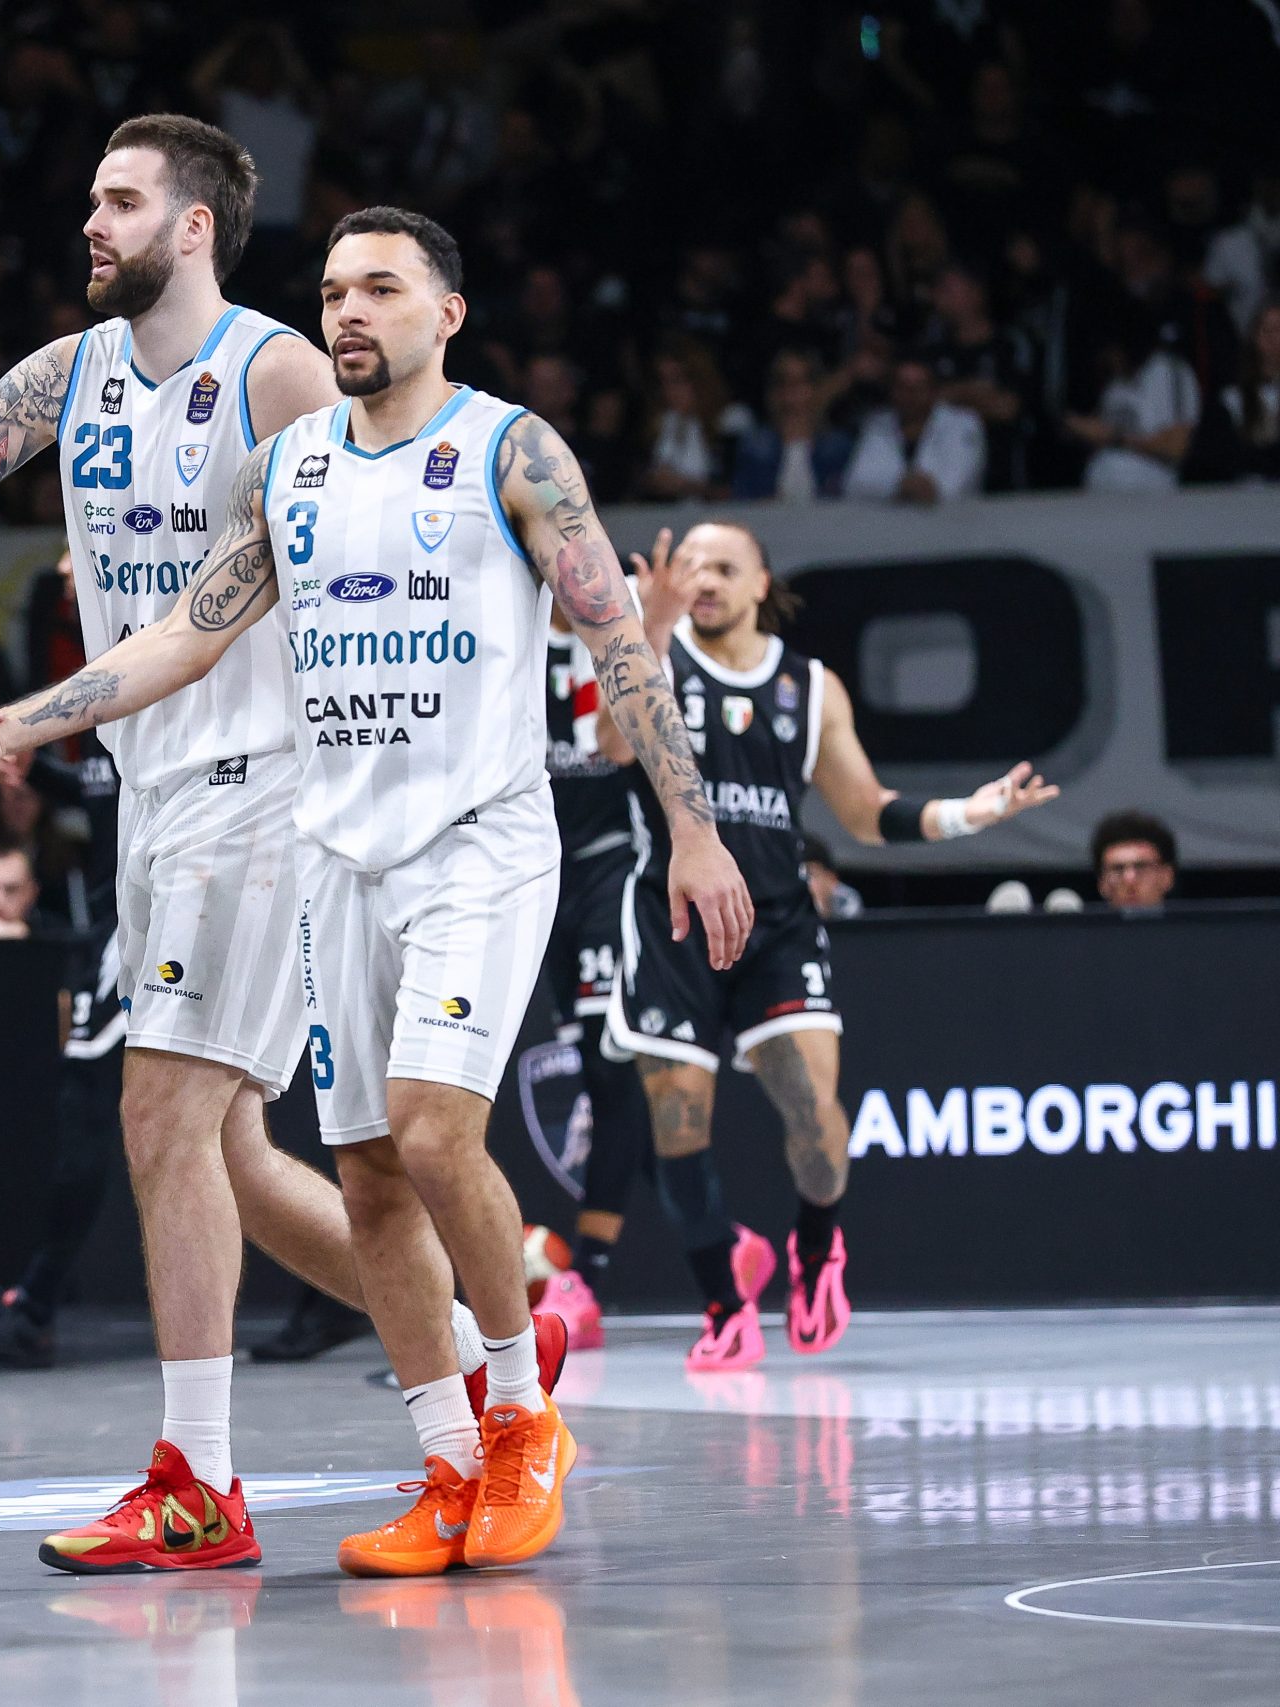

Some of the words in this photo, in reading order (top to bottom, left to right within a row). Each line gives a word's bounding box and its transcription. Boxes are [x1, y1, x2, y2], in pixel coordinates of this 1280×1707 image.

[193, 395, 213, 403] LBA
[73, 423, 132, 489] 23
[430, 460, 453, 468] LBA
[171, 503, 207, 533] tabu
[287, 501, 319, 565] 3
[301, 579, 321, 590] BCC
[340, 578, 384, 598] Ford
[408, 570, 449, 600] tabu
[289, 619, 477, 673] S.Bernardo
[316, 728, 411, 747] ARENA
[174, 988, 203, 1001] VIAGGI
[418, 1016, 460, 1030] FRIGERIO
[462, 1024, 490, 1038] VIAGGI
[309, 1025, 335, 1090] 3
[848, 1081, 1277, 1158] AMBORGHI
